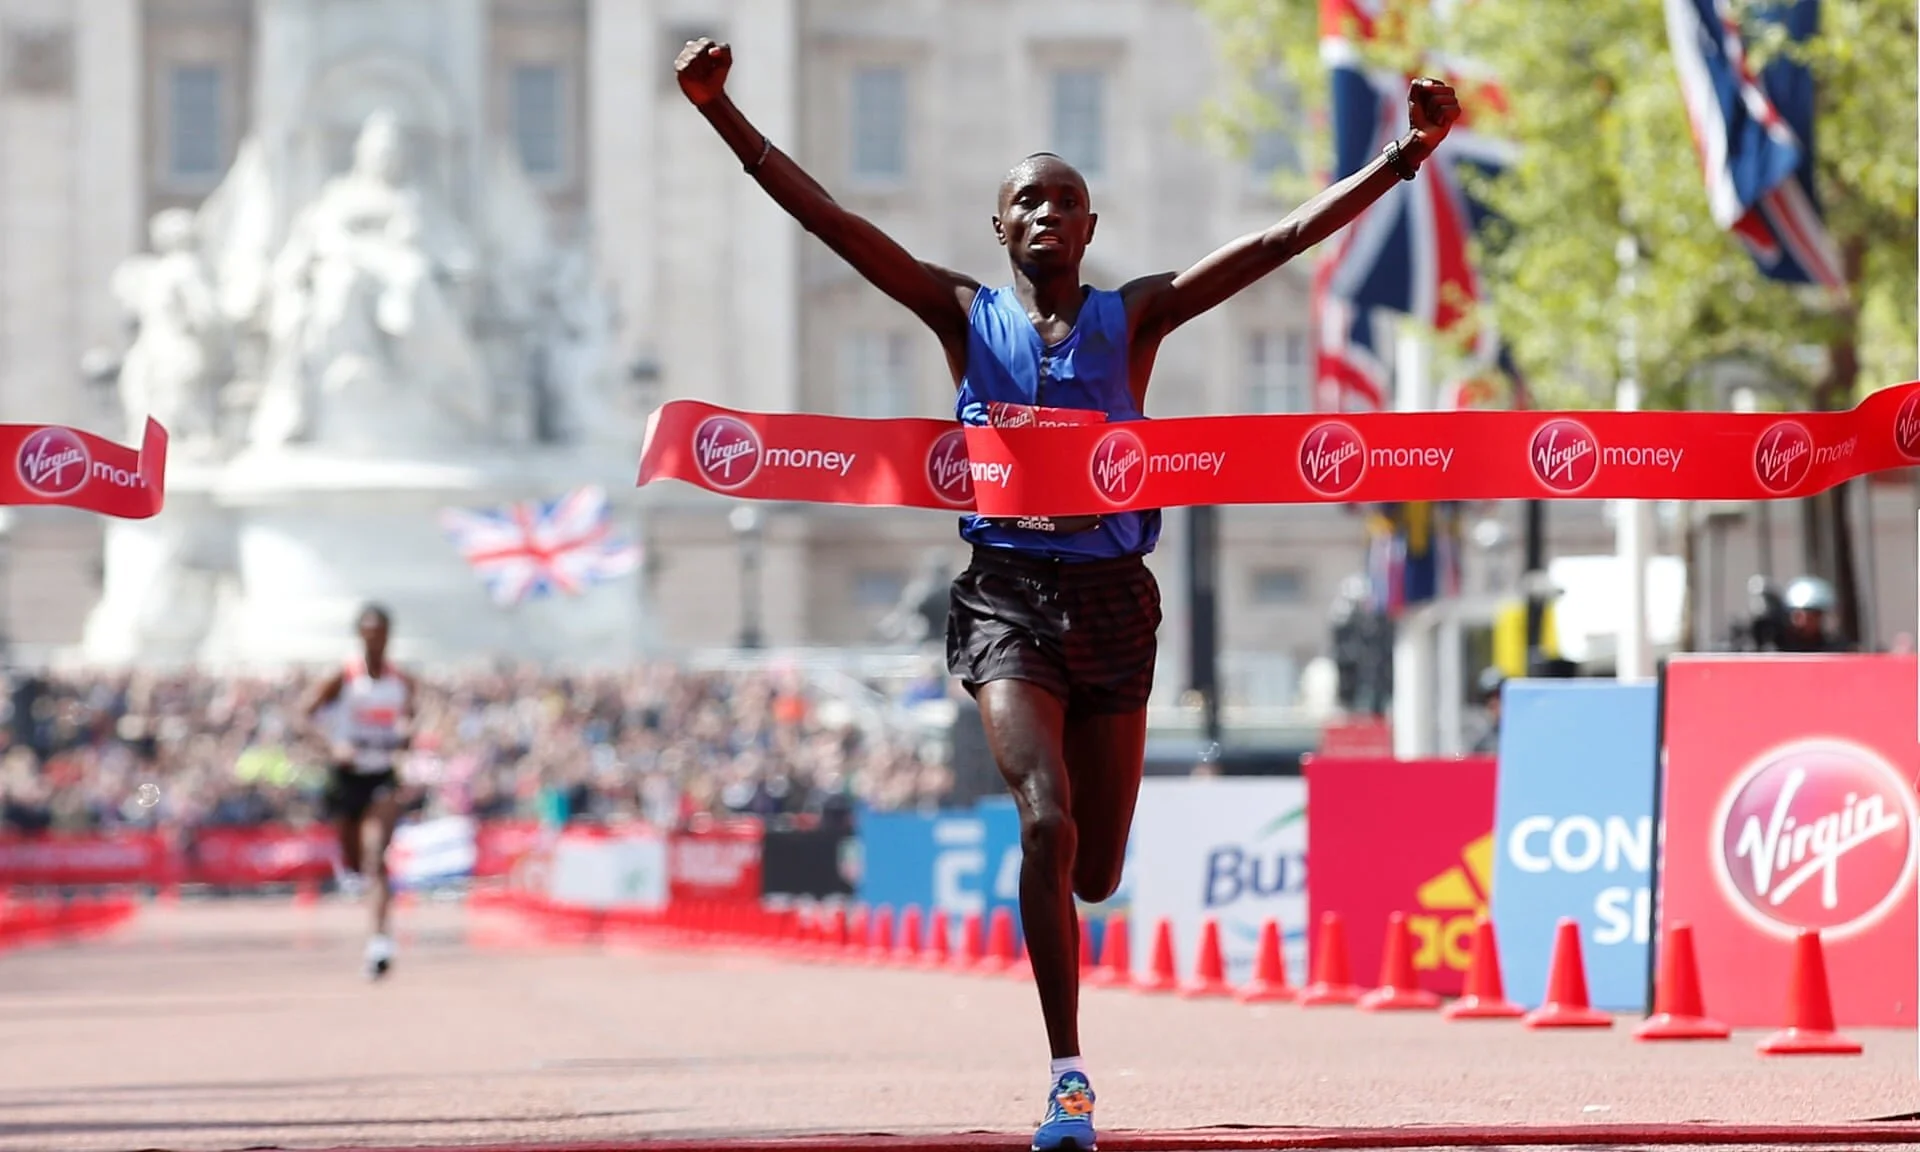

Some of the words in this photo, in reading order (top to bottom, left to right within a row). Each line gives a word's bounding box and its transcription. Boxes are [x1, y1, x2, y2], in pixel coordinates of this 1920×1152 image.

[24, 437, 84, 486] Virgin
[700, 425, 754, 477] Virgin
[764, 448, 855, 476] money
[1098, 441, 1141, 492] Virgin
[1150, 452, 1226, 475] money
[1305, 431, 1360, 485] Virgin
[1370, 448, 1454, 472] money
[1537, 430, 1592, 481] Virgin
[1603, 448, 1683, 472] money
[1761, 431, 1807, 482] Virgin
[1816, 434, 1858, 464] money
[1017, 520, 1055, 531] adidas
[1507, 815, 1652, 874] CON
[1737, 767, 1900, 909] Virgin
